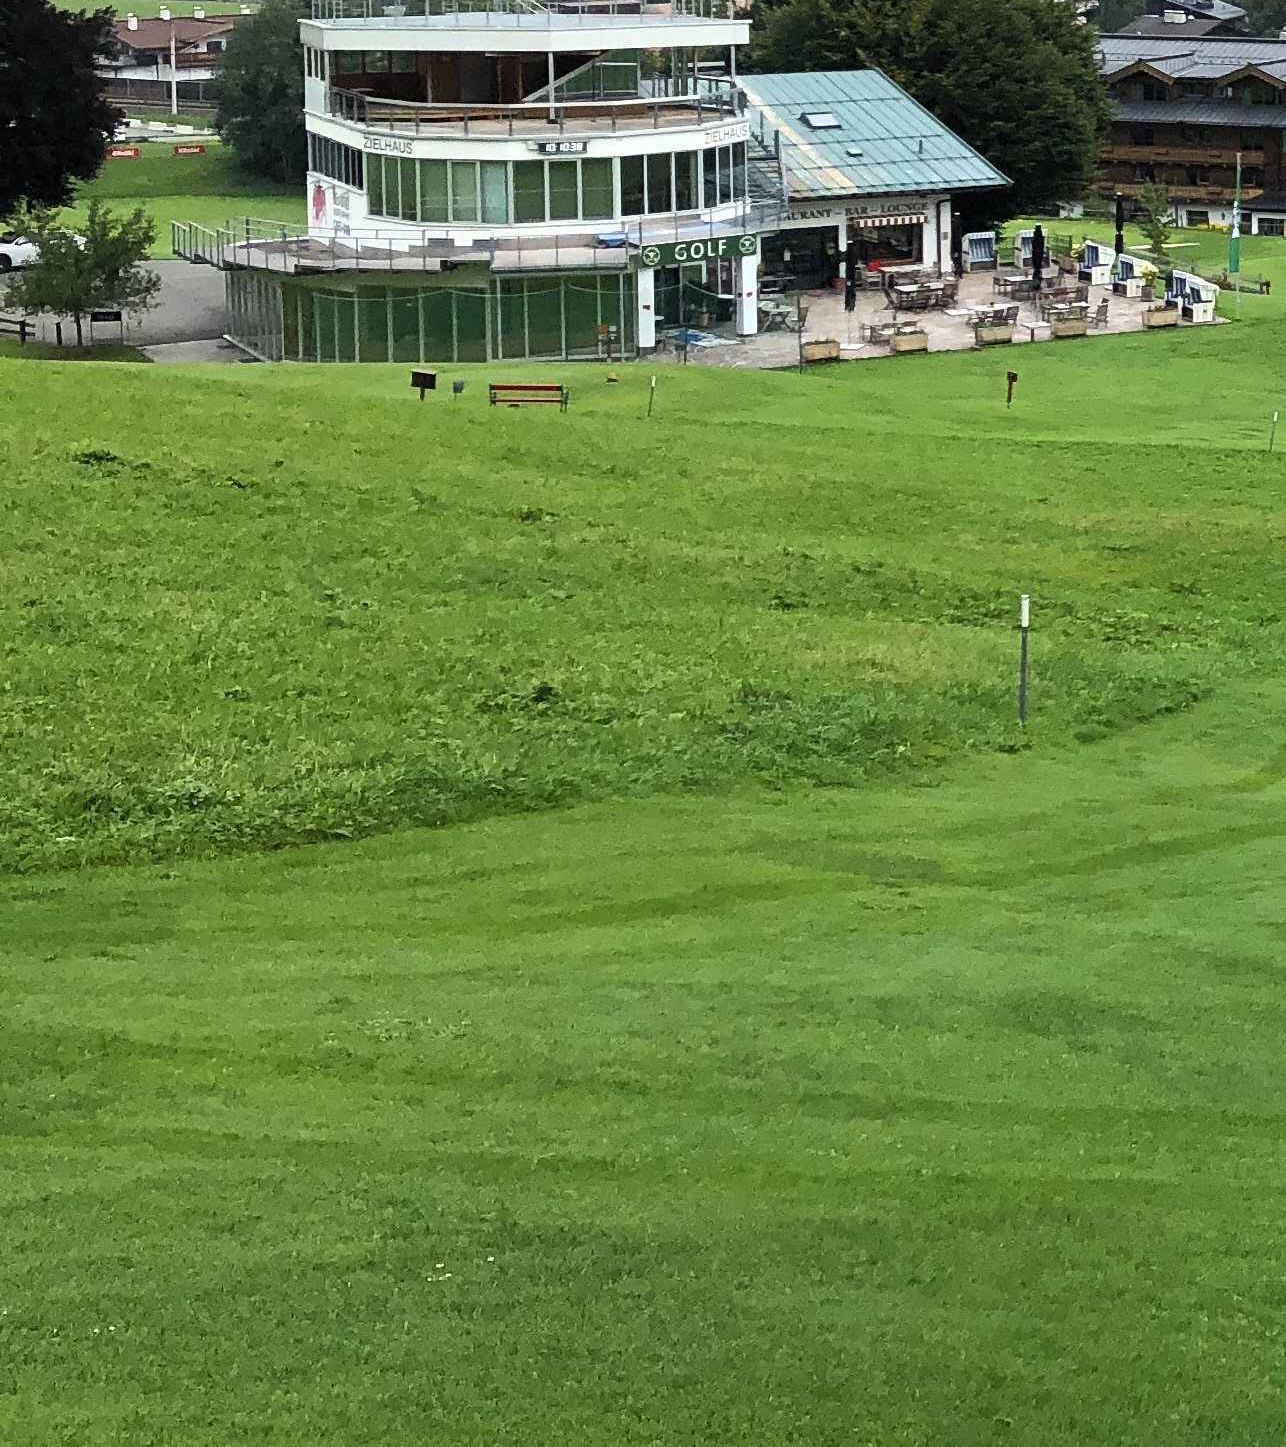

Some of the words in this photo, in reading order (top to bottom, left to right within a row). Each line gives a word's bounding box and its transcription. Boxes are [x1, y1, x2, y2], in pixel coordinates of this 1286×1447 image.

[705, 124, 748, 144] ZIELHAUS
[364, 137, 413, 154] ZIELHAUS
[845, 206, 868, 216] BAR
[880, 201, 930, 214] LOUNGE
[674, 239, 727, 261] GOLF
